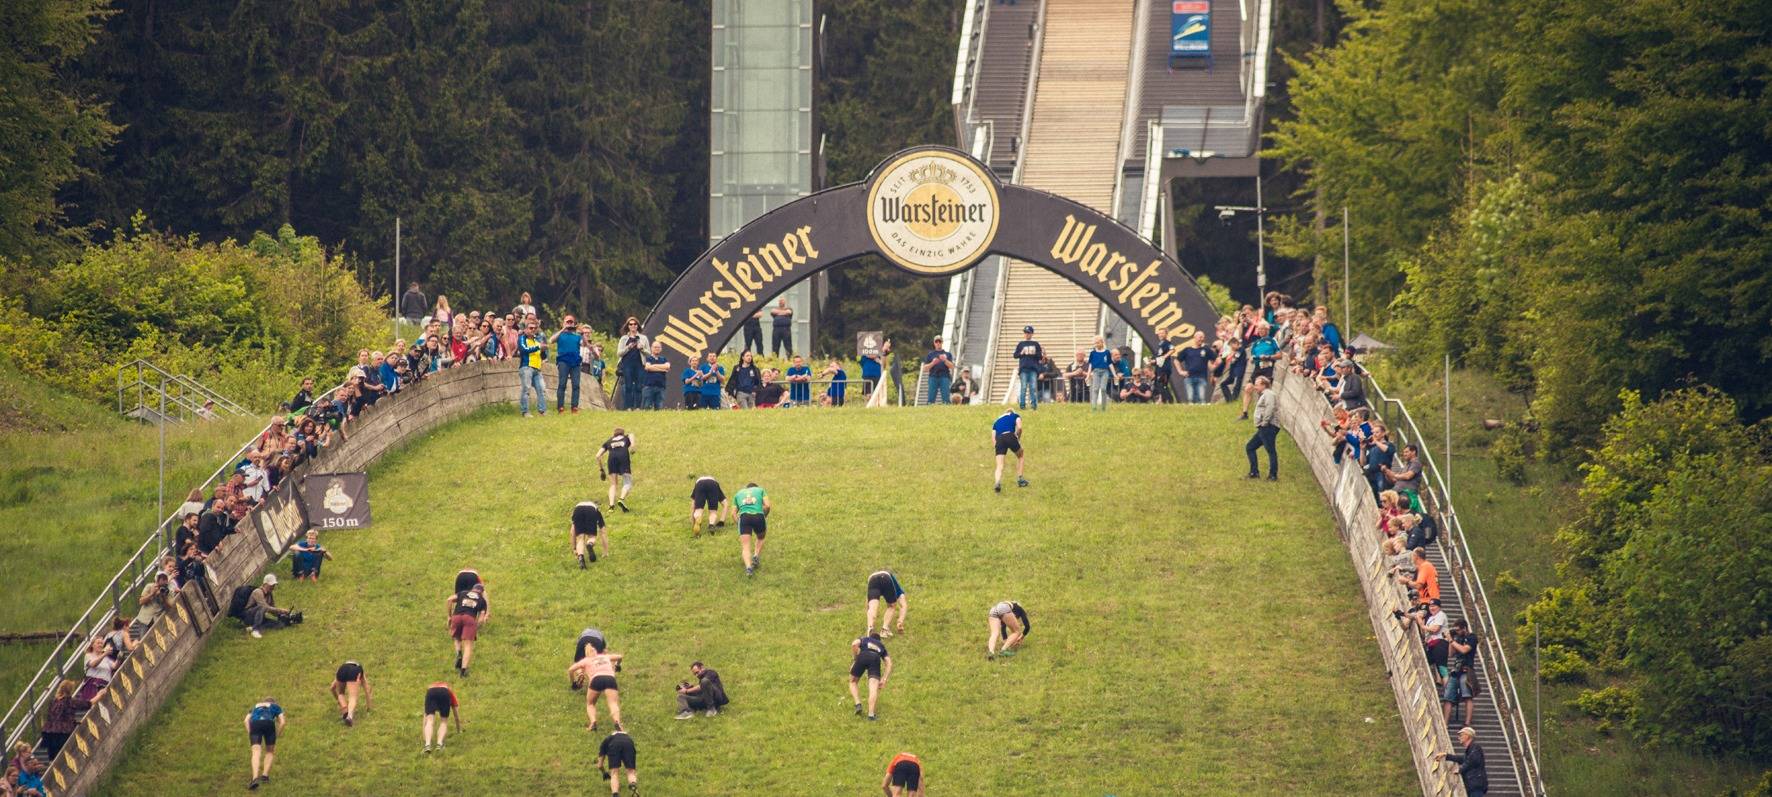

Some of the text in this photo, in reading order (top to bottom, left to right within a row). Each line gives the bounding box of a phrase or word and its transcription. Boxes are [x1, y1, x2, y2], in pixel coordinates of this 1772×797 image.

[890, 176, 906, 193] SEIT
[960, 176, 977, 194] 1753
[881, 194, 987, 227] Warsteiner
[891, 231, 977, 258] DAS EINZIG WAHRE
[655, 225, 819, 359] Warsteiner
